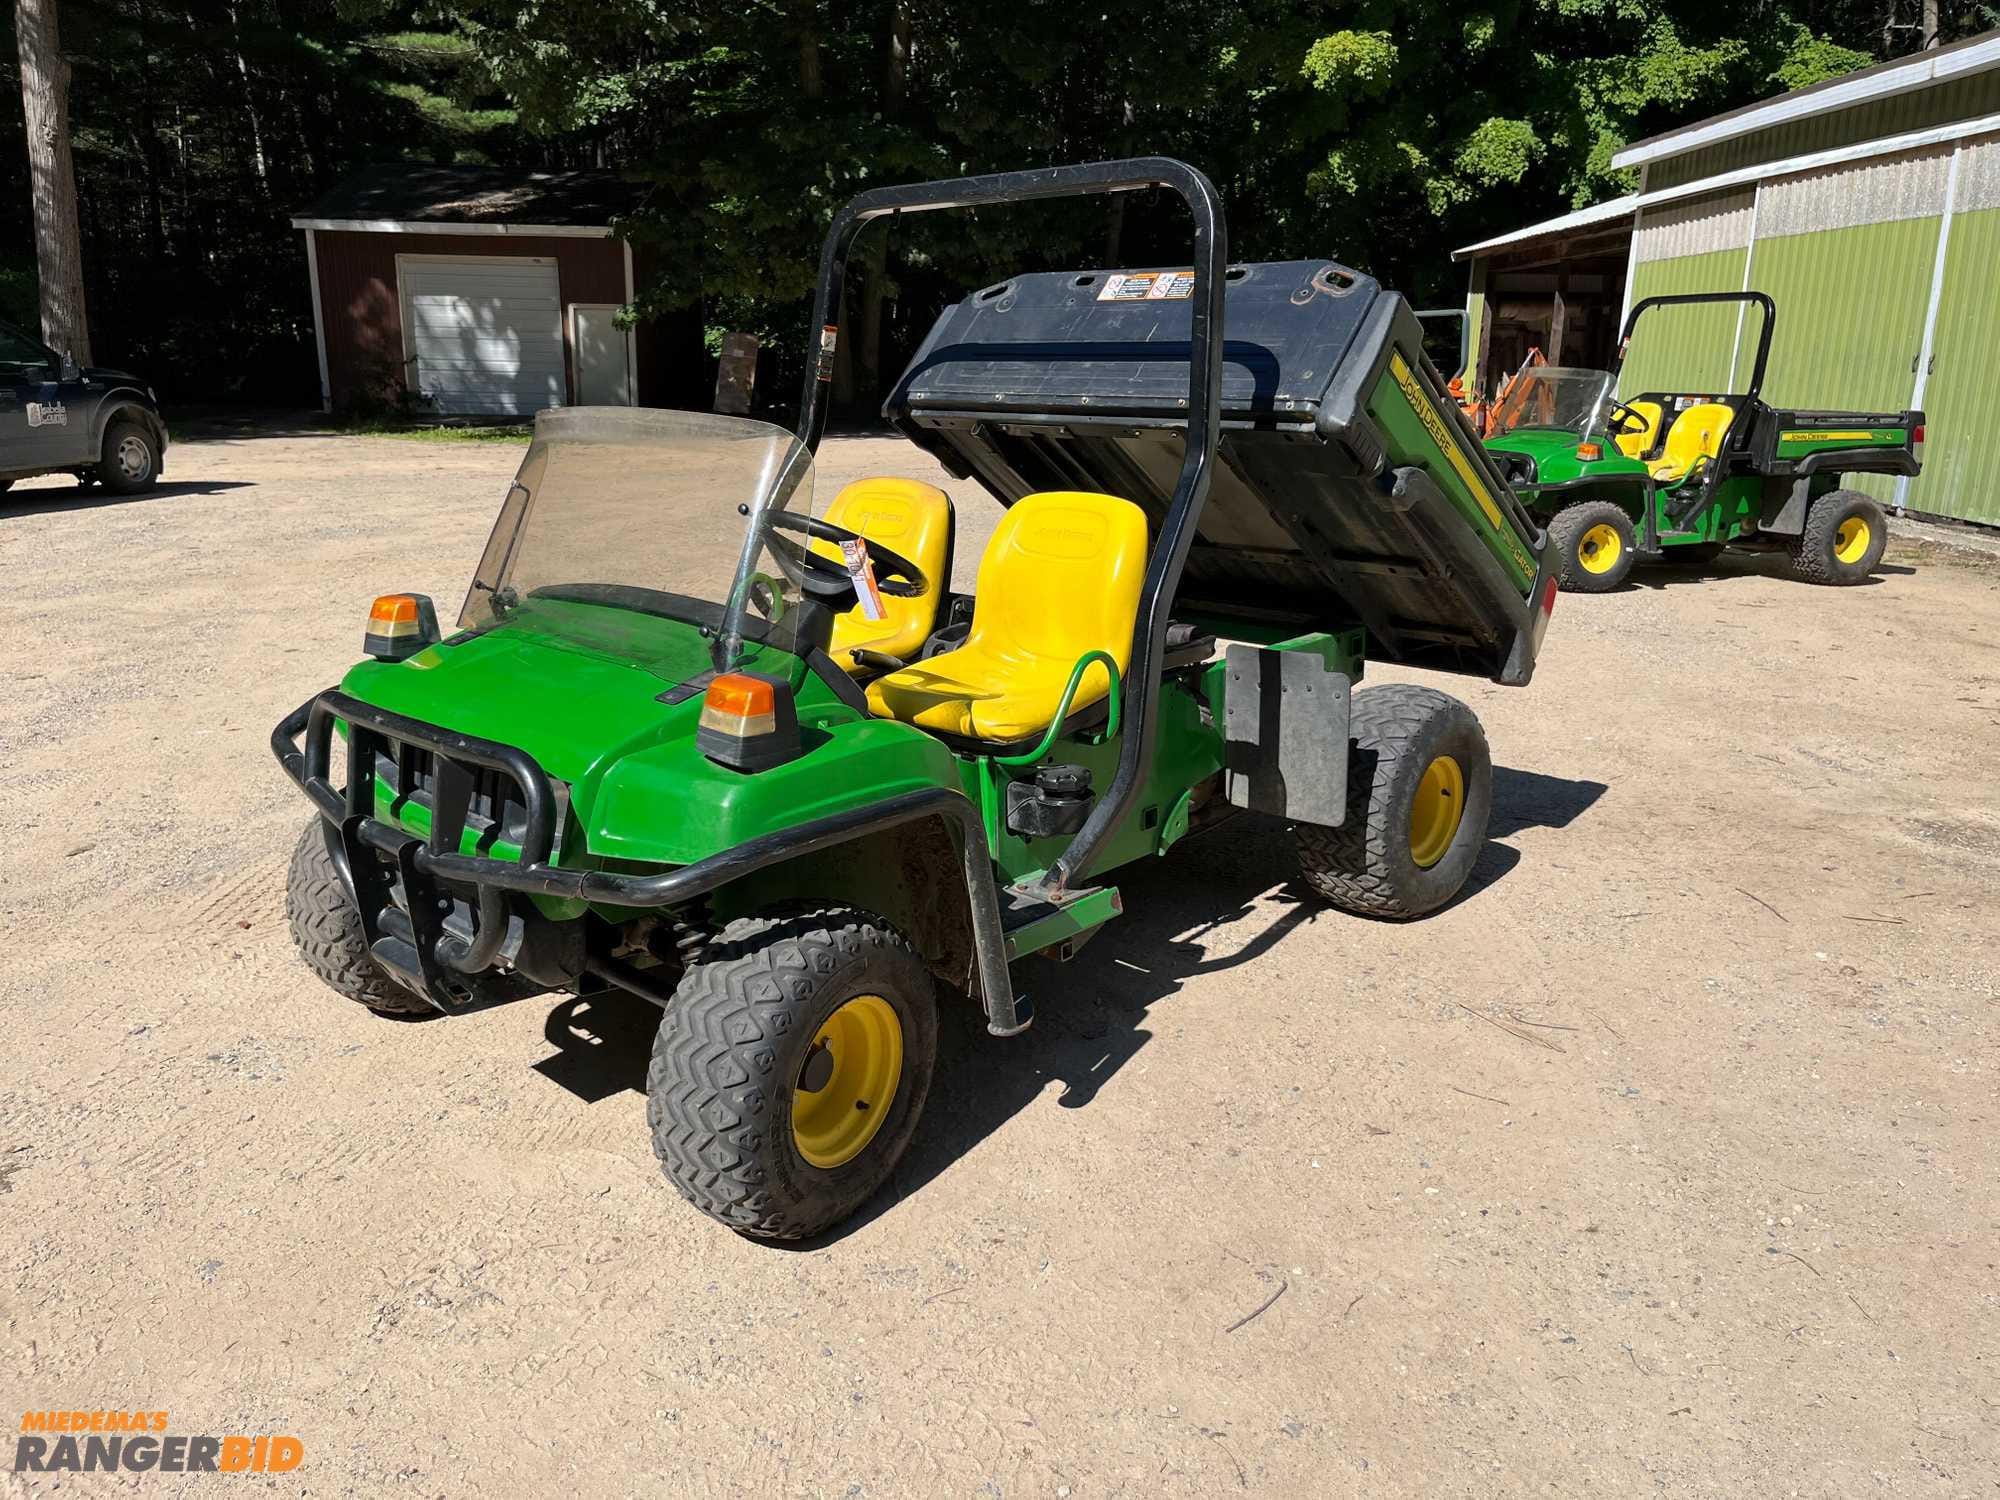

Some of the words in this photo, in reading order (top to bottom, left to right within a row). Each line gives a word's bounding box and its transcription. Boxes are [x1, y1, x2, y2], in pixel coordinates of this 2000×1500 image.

[1401, 375, 1425, 415] JOHN
[1424, 408, 1451, 456] DEERE
[1514, 548, 1534, 580] GATOR
